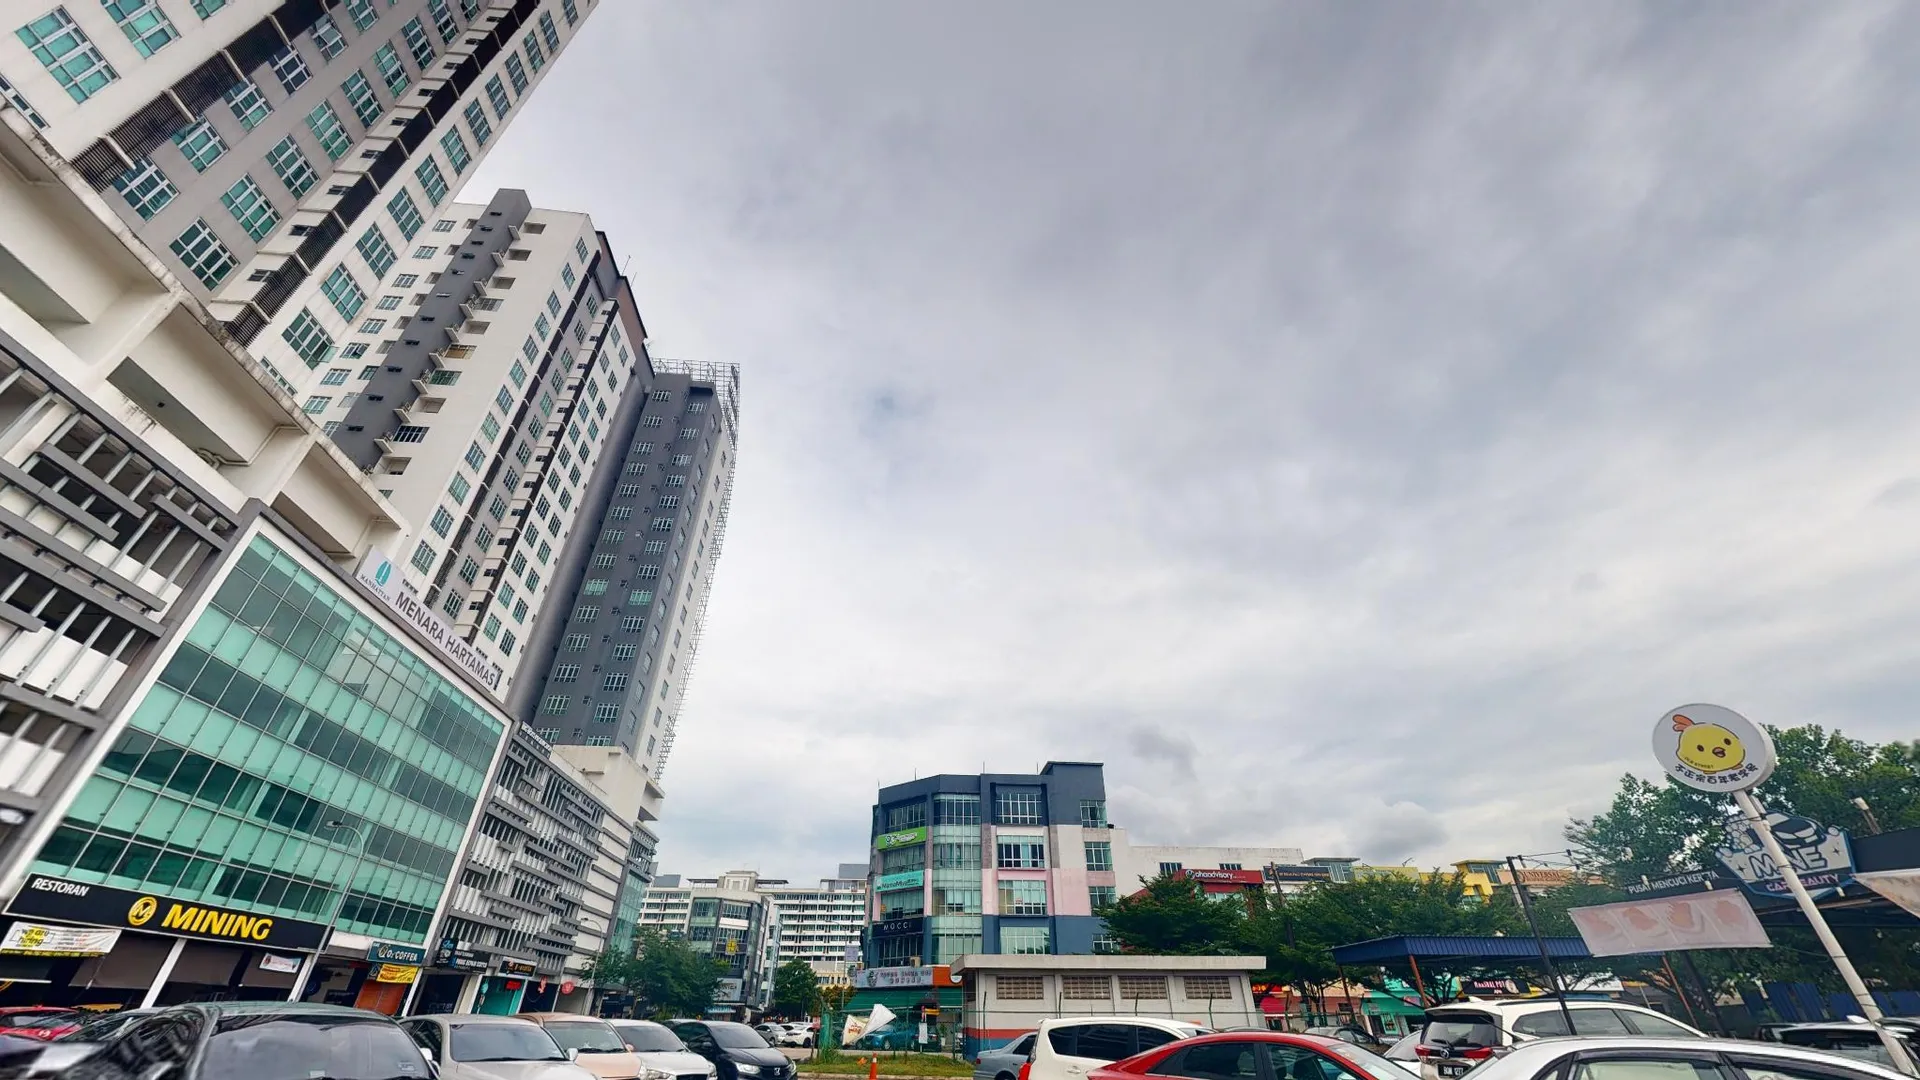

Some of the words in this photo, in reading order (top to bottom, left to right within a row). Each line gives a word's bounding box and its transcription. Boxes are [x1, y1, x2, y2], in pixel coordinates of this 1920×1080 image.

[361, 574, 391, 601] MANHATTAN
[395, 591, 445, 644] MENARA
[445, 635, 496, 687] HARTAMAS
[1749, 846, 1828, 879] MNE
[31, 878, 90, 897] RESTORAN
[1651, 876, 1688, 890] MENCUCI
[1687, 870, 1720, 884] KERTA
[1798, 873, 1840, 890] EAUTY
[161, 904, 273, 941] MINING
